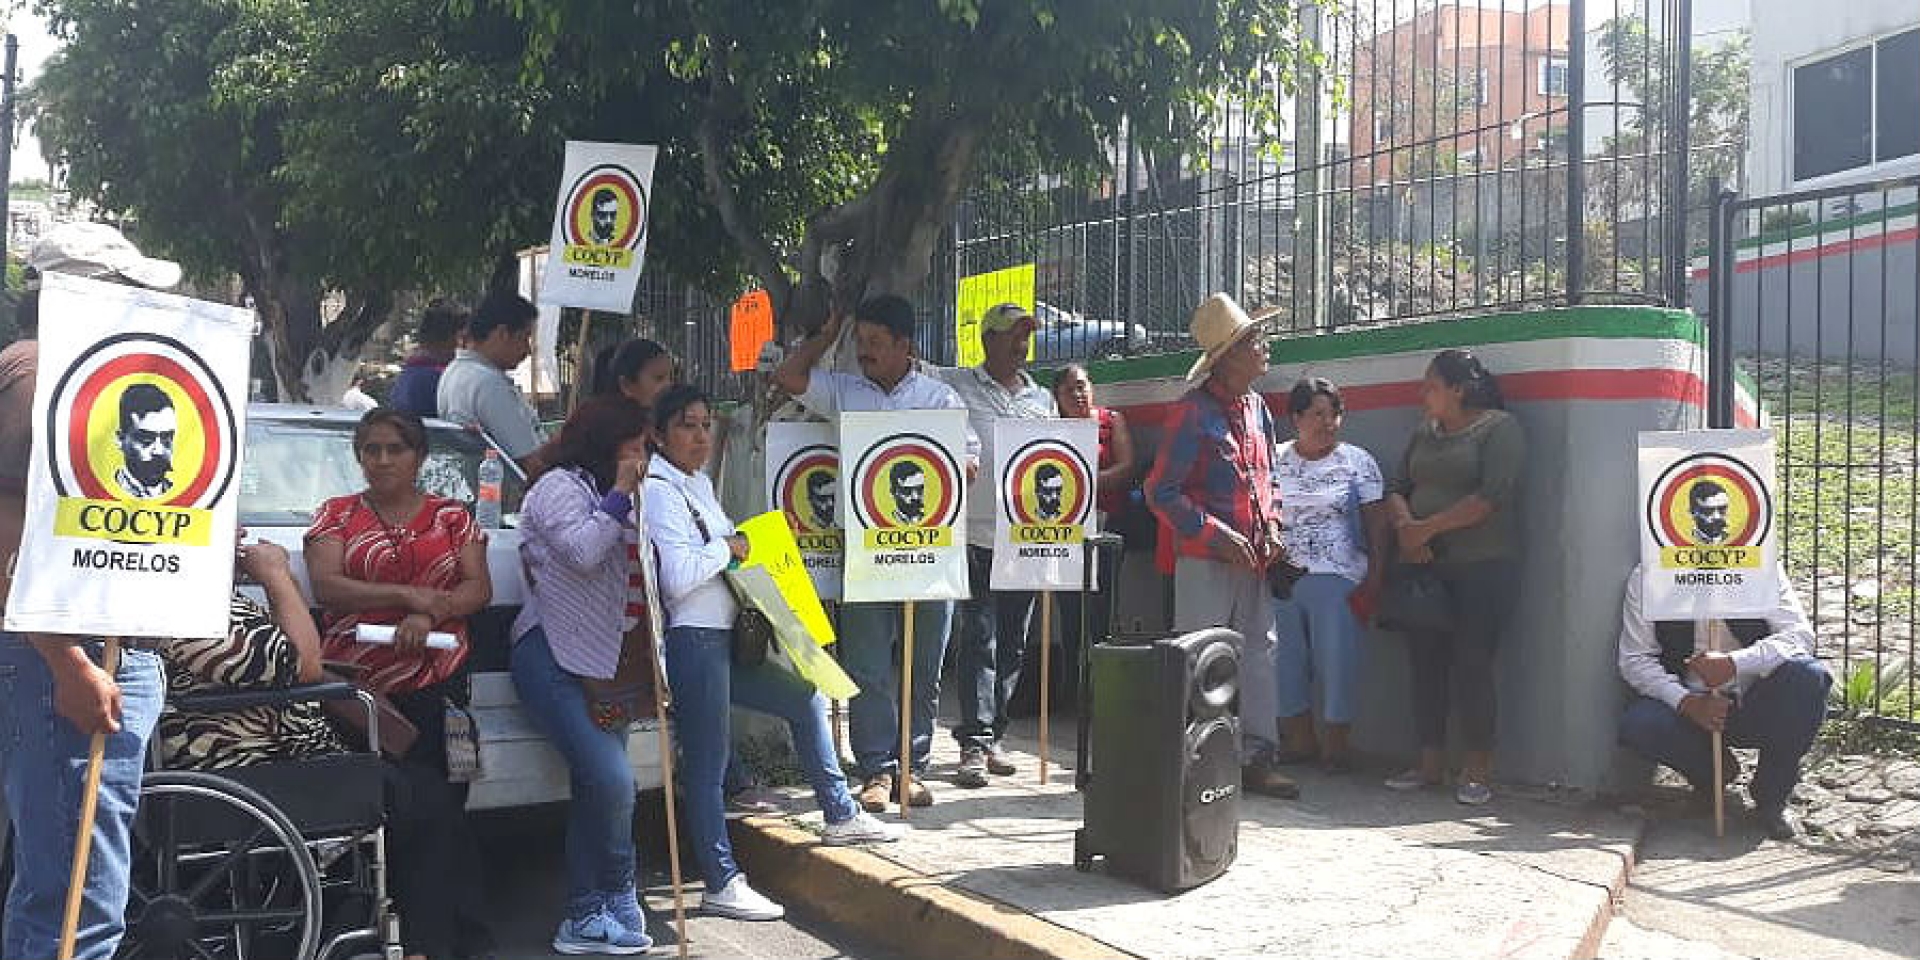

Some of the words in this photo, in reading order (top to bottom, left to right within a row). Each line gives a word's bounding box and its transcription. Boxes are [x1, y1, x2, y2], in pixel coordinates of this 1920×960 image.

[79, 504, 191, 538] COCYP
[876, 530, 940, 545] COCYP
[1020, 527, 1072, 541] COCYP
[72, 548, 181, 573] MORELOS
[874, 553, 936, 565] MORELOS
[1674, 549, 1746, 564] COCYP
[1674, 573, 1744, 586] MORELOS
